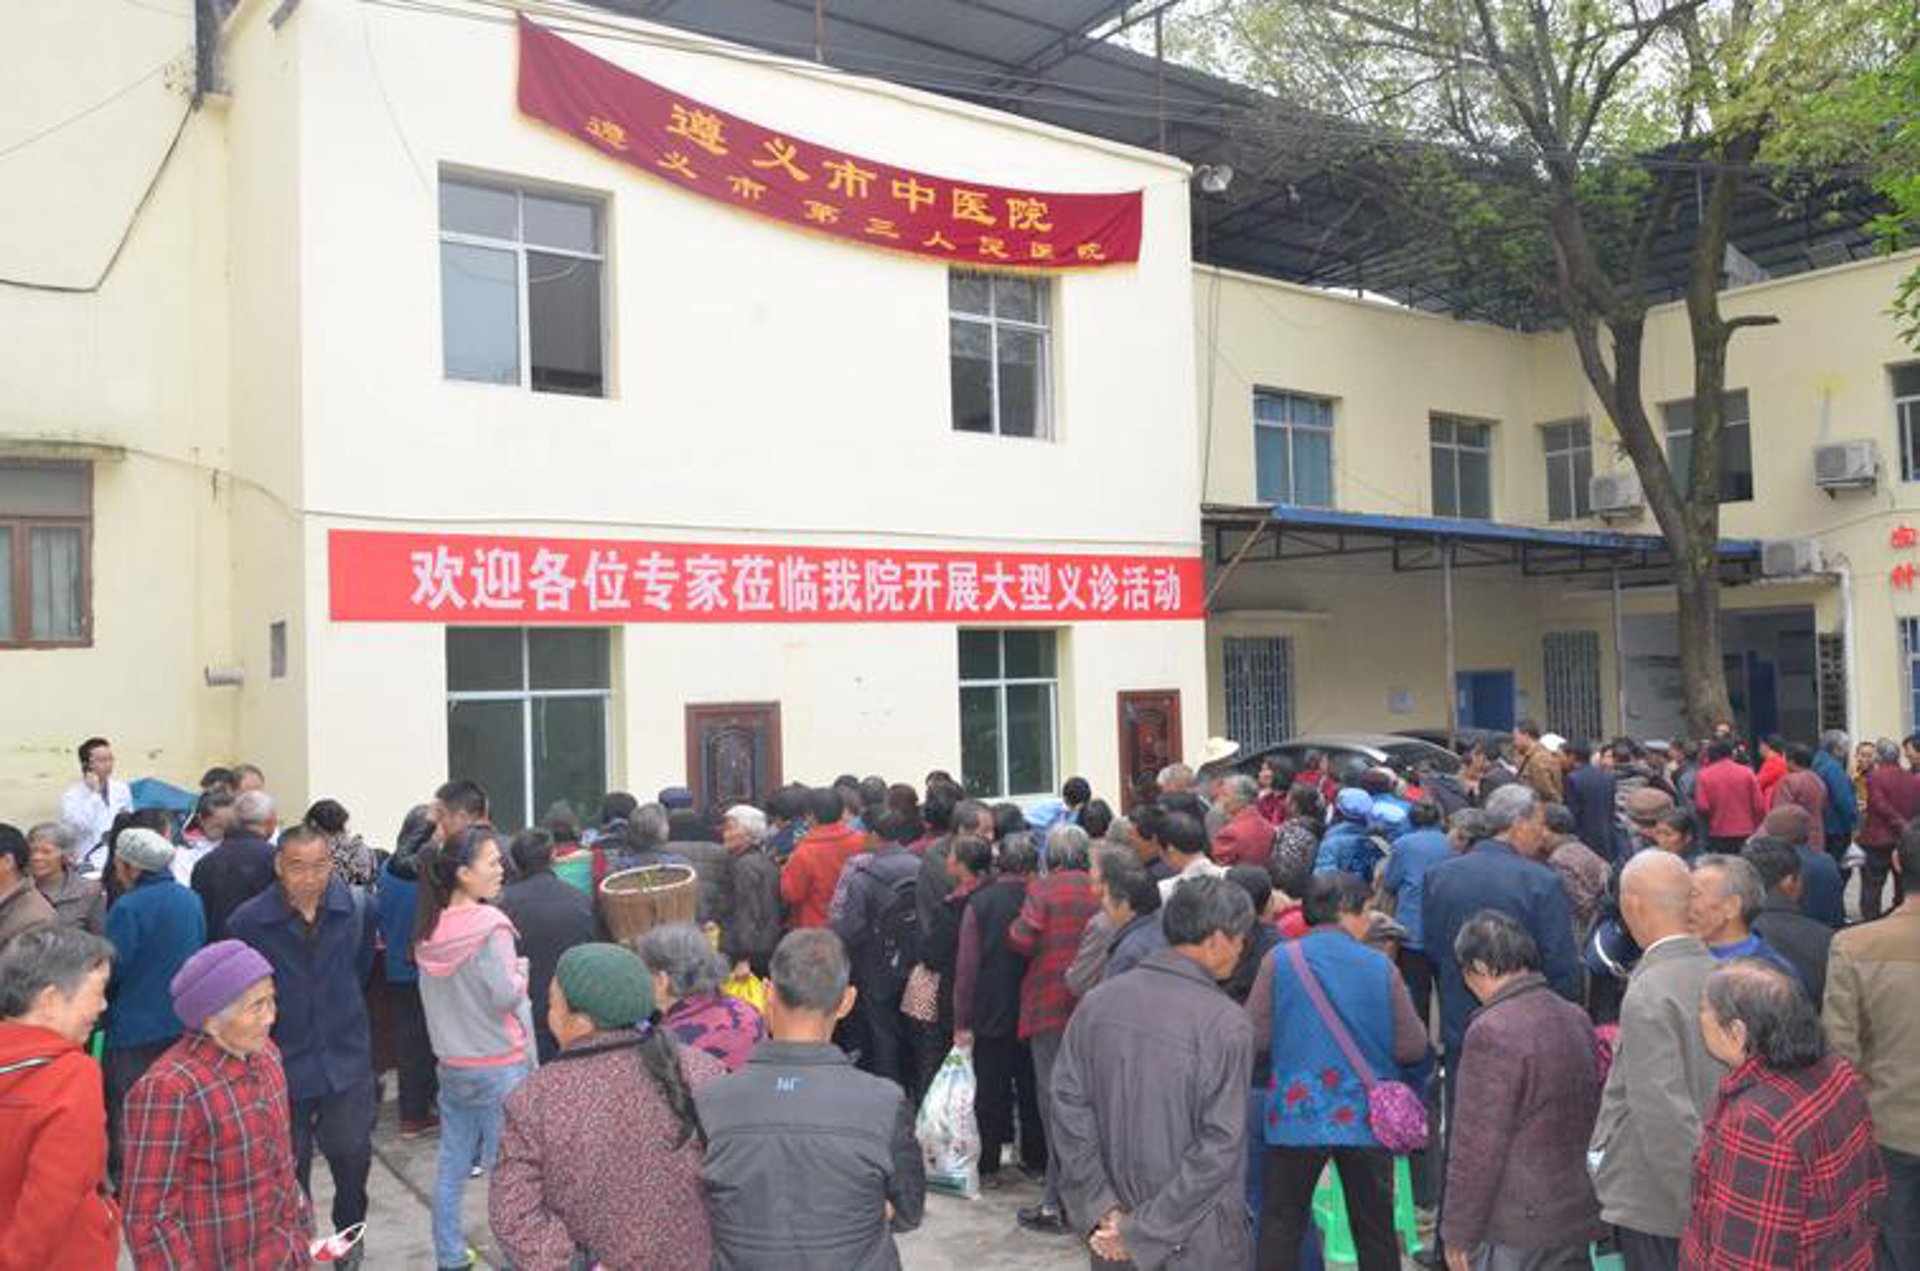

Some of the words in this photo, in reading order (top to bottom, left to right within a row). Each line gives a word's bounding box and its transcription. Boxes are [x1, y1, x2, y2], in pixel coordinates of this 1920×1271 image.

[584, 116, 1105, 261] 遵义市第三人民医院
[666, 103, 1053, 231] 遵义市中医院
[410, 545, 1181, 612] 欢迎各位专家莅临我院开展大型义诊活动
